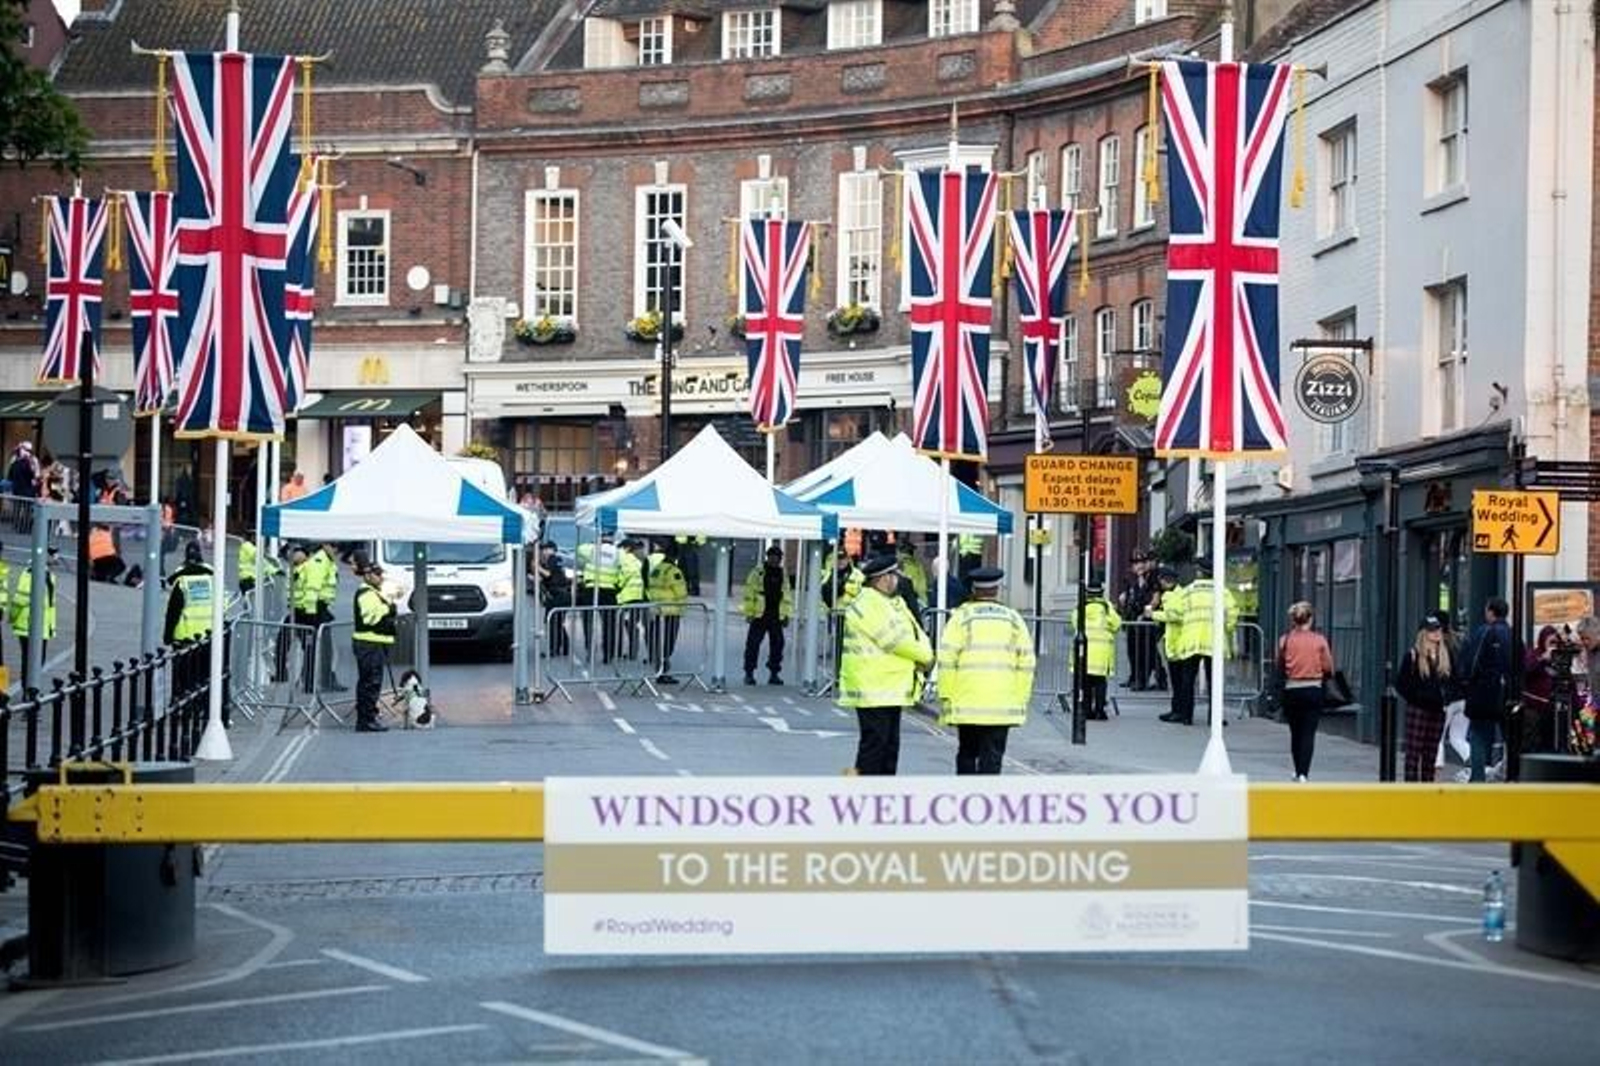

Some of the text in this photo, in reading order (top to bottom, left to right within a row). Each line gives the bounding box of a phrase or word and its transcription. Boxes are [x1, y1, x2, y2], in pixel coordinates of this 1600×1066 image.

[627, 380, 657, 396] THE
[698, 376, 730, 393] AND
[825, 370, 875, 385] FREE HOUSE
[515, 381, 588, 393] WETHERSPOON
[1305, 380, 1353, 398] Zizzi
[1310, 400, 1350, 417] ITALIAN
[1030, 459, 1134, 472] GUARD CHANGE
[1042, 472, 1122, 486] Expect delays
[1488, 494, 1529, 509] Royal
[1477, 508, 1539, 526] Wedding
[591, 791, 1200, 827] WINDSOR WELCOMES YOU
[658, 850, 1131, 886] TO THE ROYAL WEDDING
[592, 917, 735, 937] #RoyalWedding
